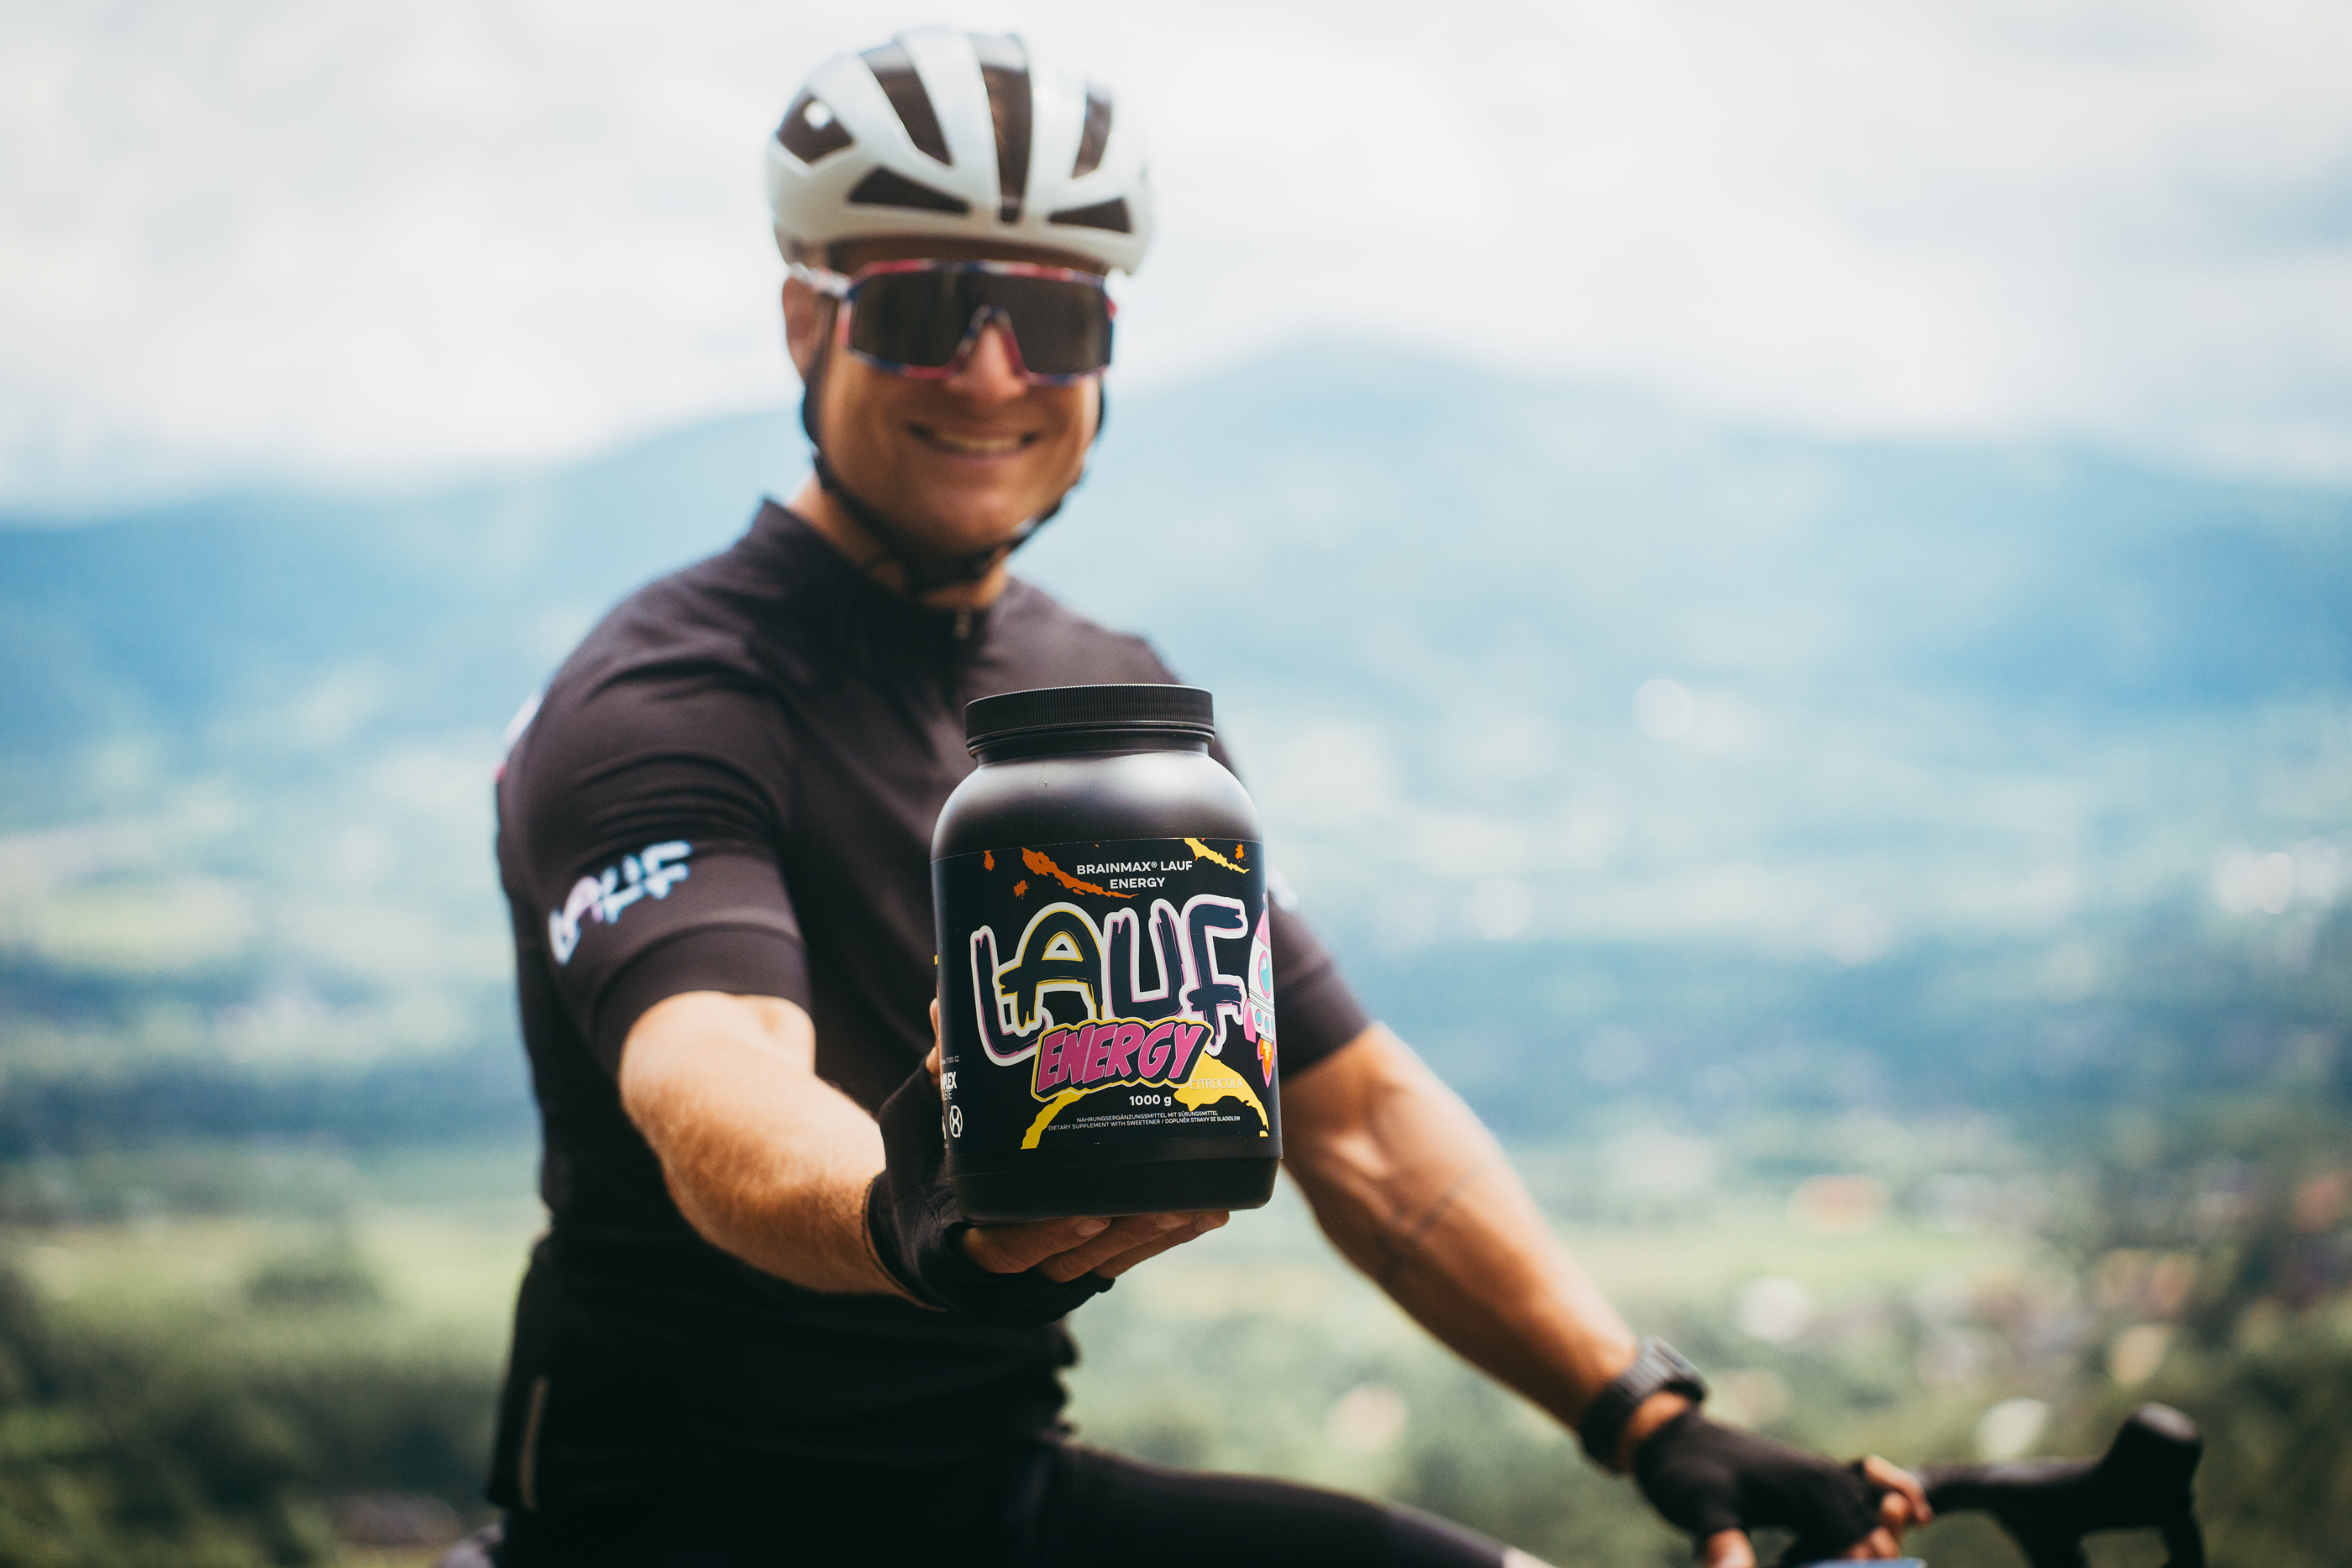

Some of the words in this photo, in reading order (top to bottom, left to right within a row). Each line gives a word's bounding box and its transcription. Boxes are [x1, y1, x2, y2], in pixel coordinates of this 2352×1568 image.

[1160, 860, 1193, 872] LAUF
[1110, 877, 1166, 889] ENERGY
[970, 894, 1248, 1067] LAUF
[1034, 1020, 1207, 1094] ENERGY
[1189, 1078, 1243, 1090] CITROCOLA
[1129, 1093, 1161, 1106] 1000
[1163, 1095, 1172, 1107] g
[1072, 1121, 1110, 1130] SUPPLEMENT
